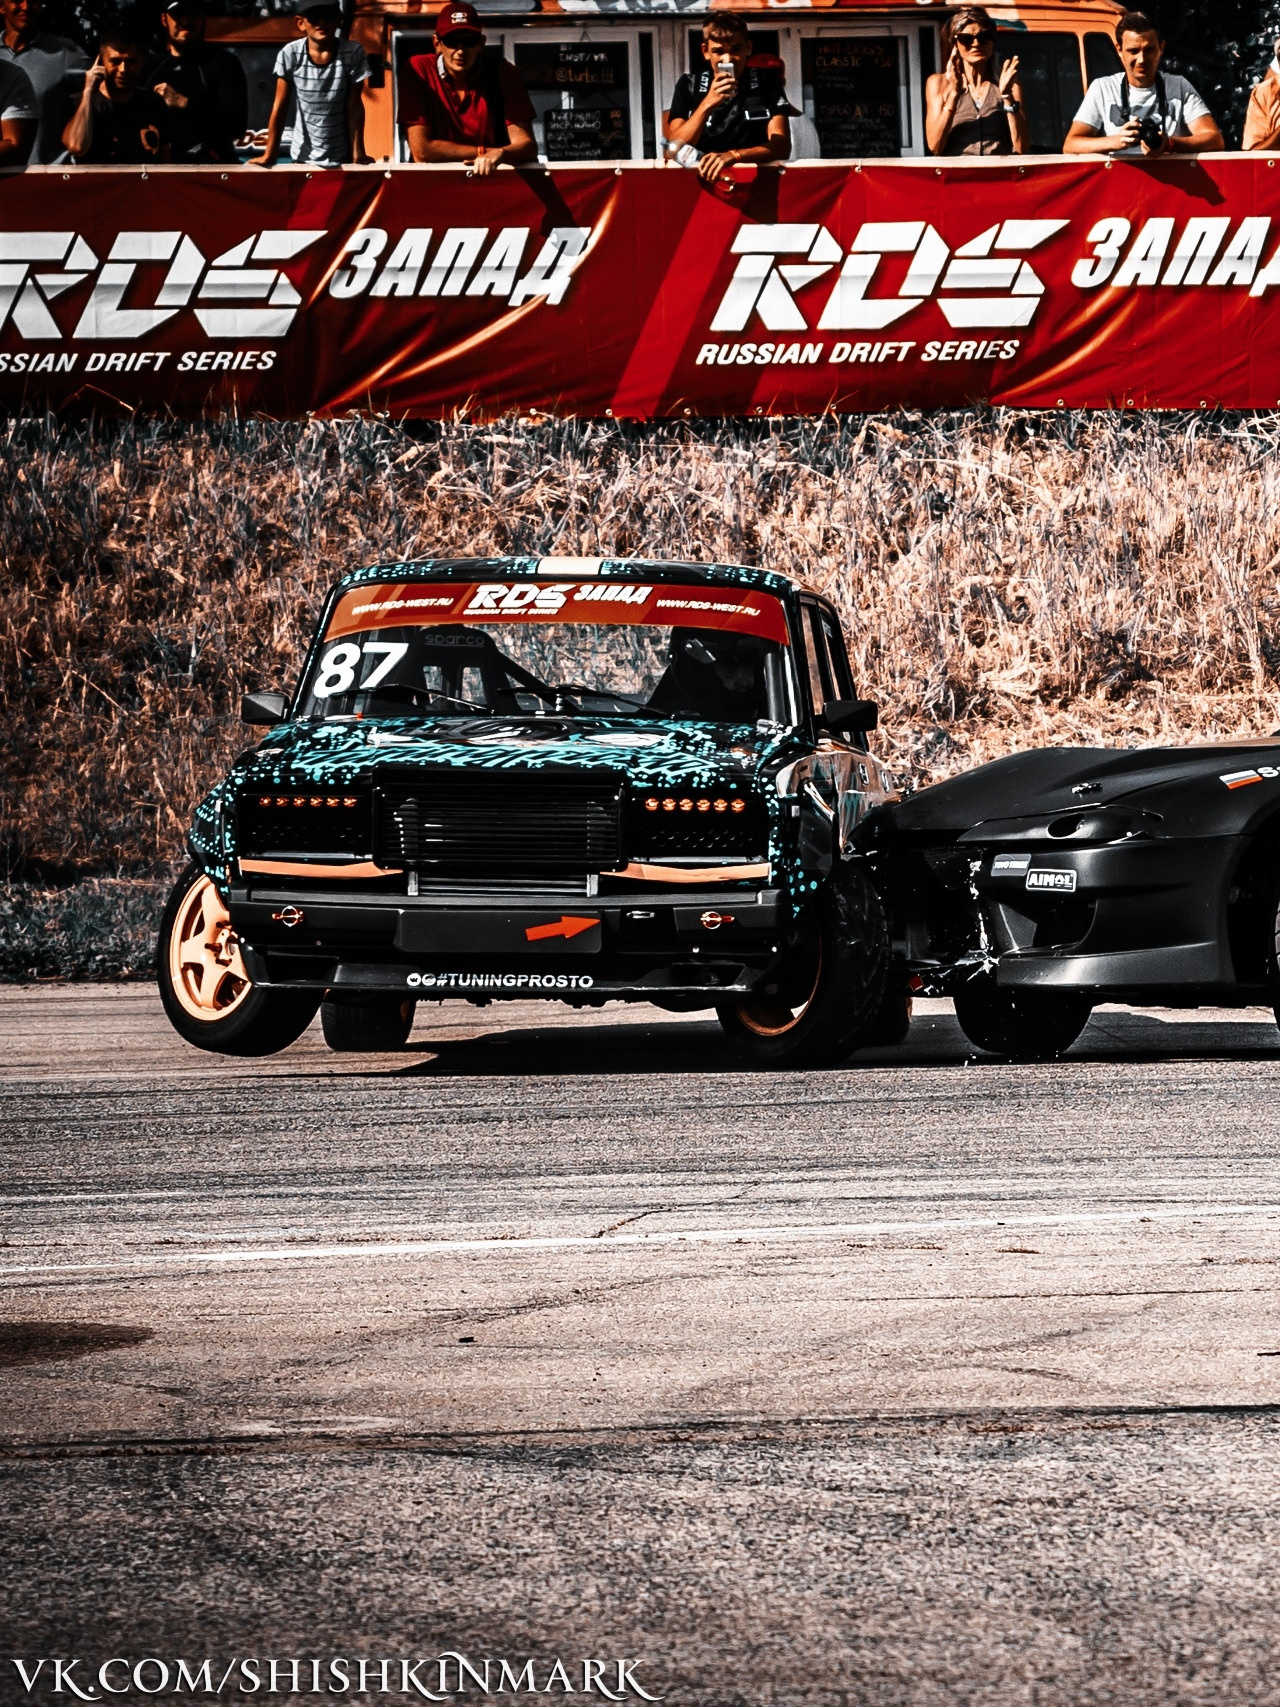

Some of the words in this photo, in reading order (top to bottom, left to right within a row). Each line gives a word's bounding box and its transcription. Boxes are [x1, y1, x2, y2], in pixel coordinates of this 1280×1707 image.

[328, 227, 591, 306] ЗАПАД
[709, 219, 1071, 332] RDS
[85, 352, 171, 372] DRIFT
[177, 351, 277, 372] SERIES
[696, 343, 824, 366] RUSSIAN
[828, 341, 917, 364] DRIFT
[919, 339, 1020, 362] SERIES
[467, 583, 577, 609] RDS
[573, 584, 654, 605] ЗАПАД
[424, 633, 486, 647] sparco
[313, 642, 409, 699] 87
[1028, 873, 1073, 887] AIMOL
[436, 973, 594, 988] #TUNINGPROSTO
